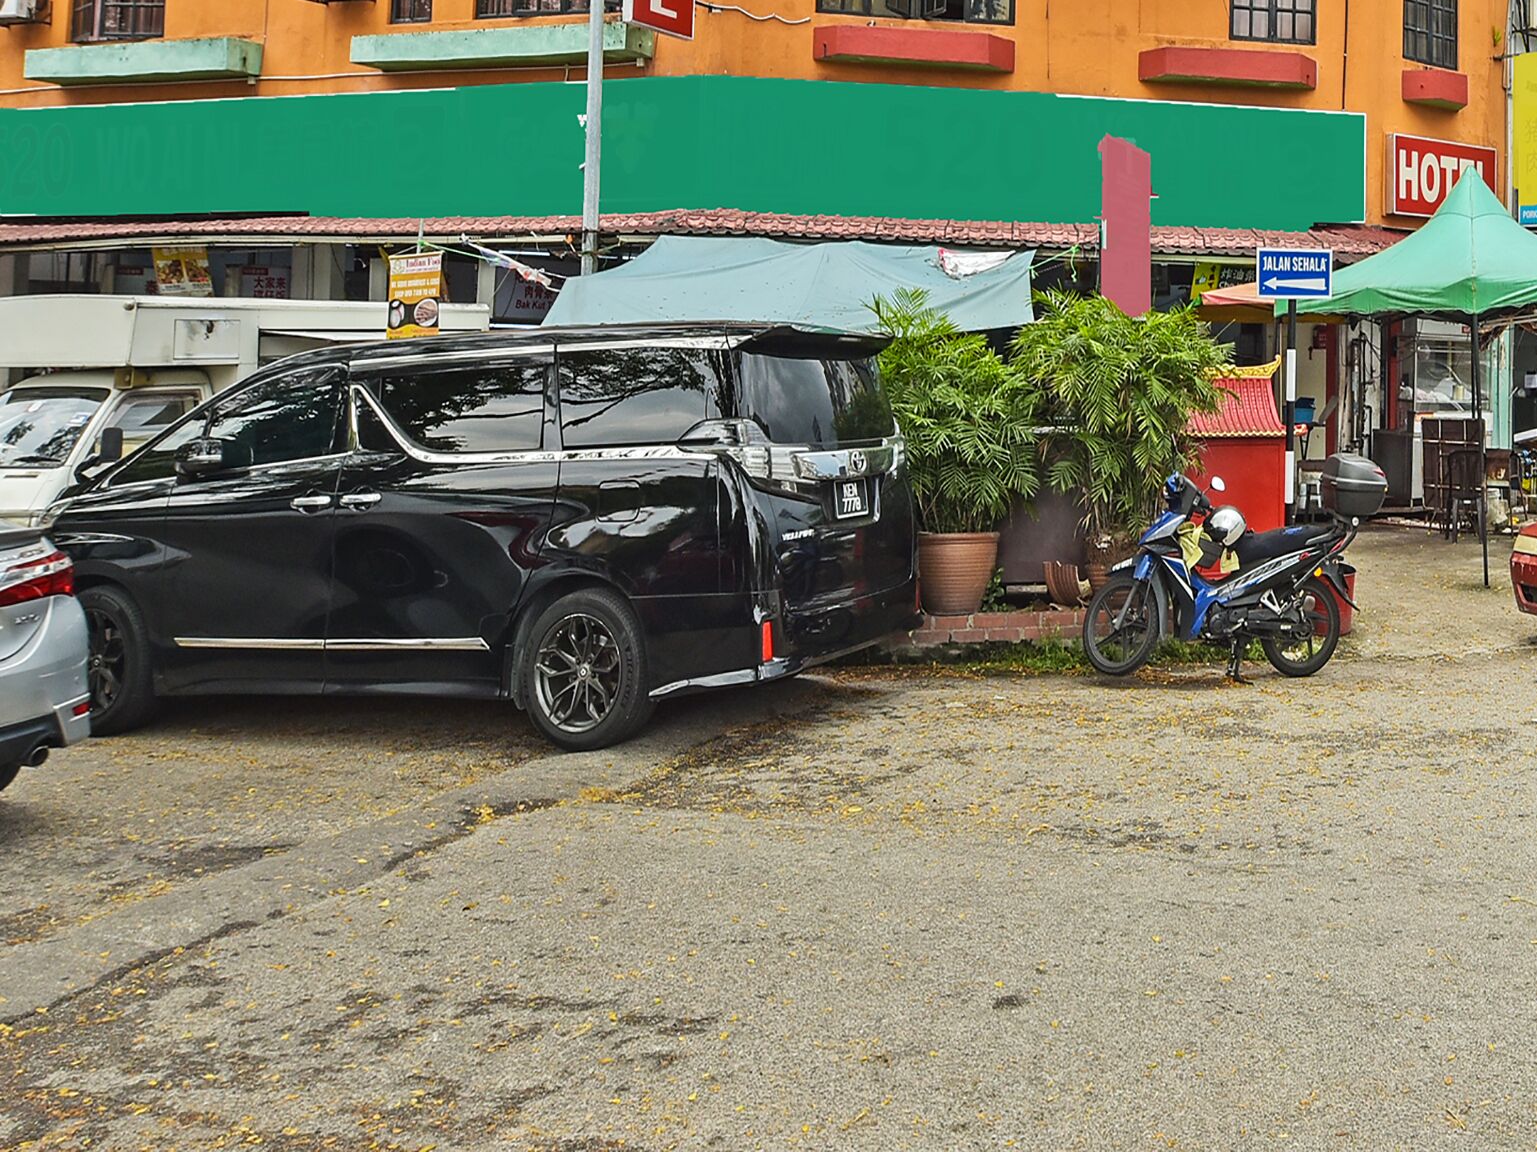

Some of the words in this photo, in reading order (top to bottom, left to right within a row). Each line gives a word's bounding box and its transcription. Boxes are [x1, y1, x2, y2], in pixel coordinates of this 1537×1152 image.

[1522, 209, 1537, 219] PORK
[1262, 256, 1291, 272] JALAN
[1292, 256, 1327, 272] SEHALA
